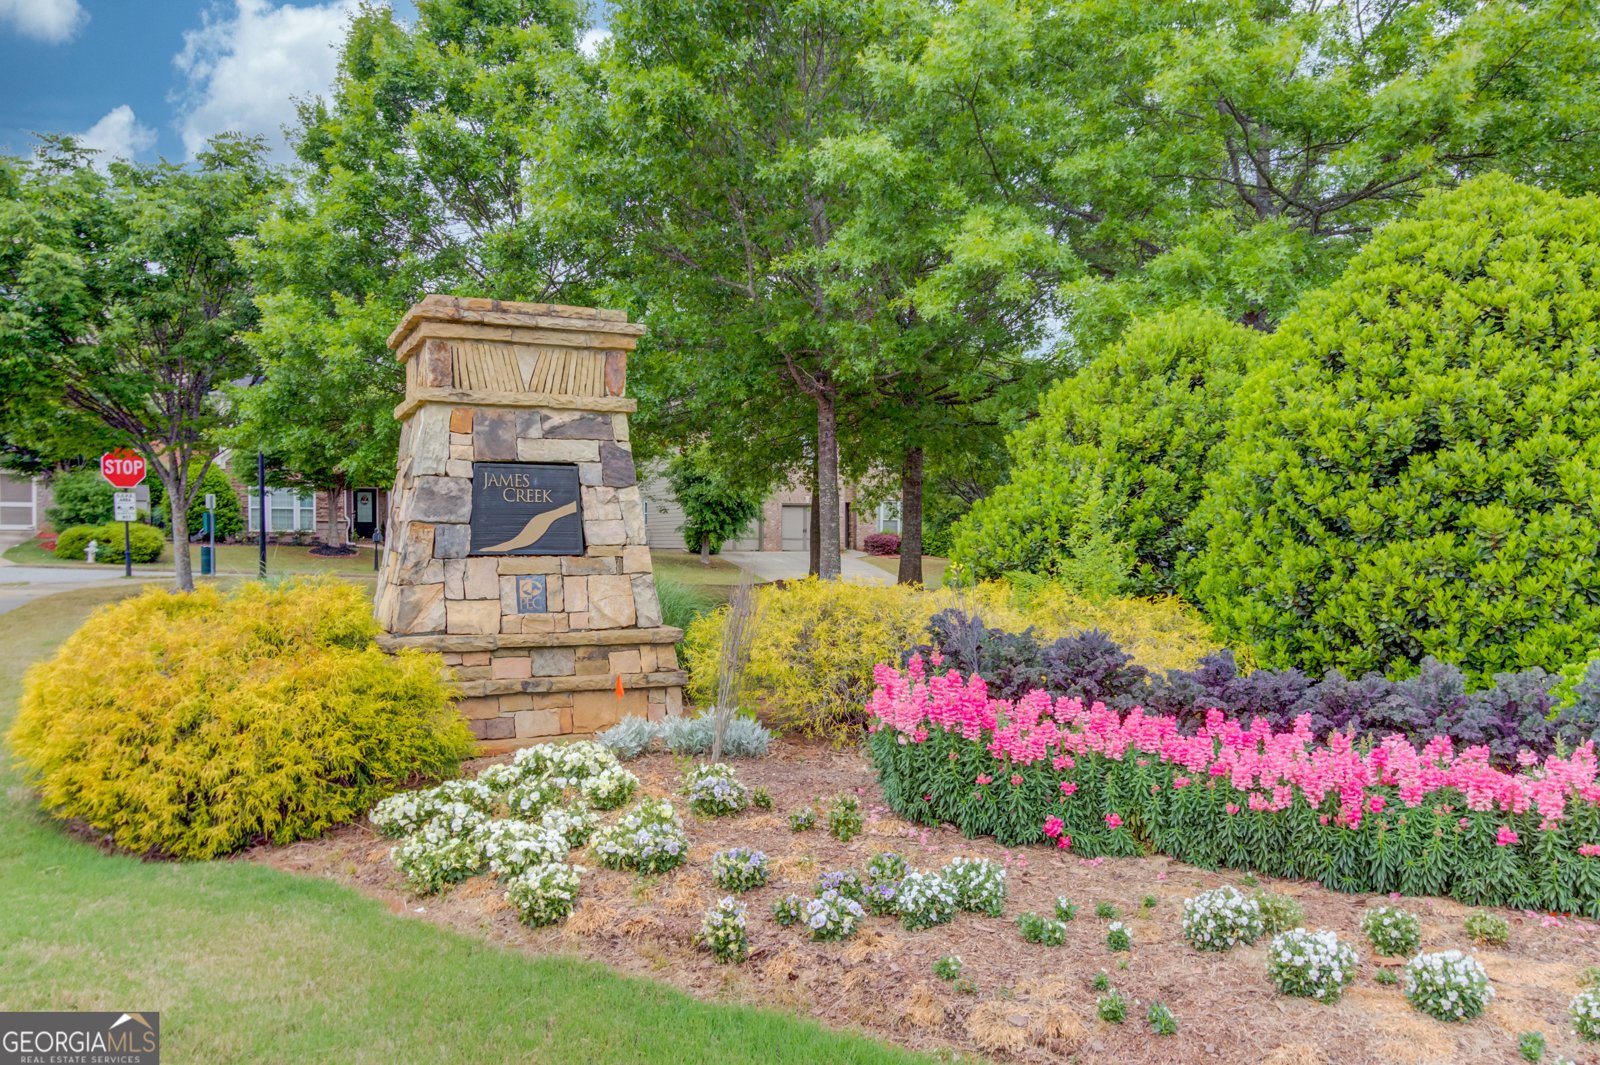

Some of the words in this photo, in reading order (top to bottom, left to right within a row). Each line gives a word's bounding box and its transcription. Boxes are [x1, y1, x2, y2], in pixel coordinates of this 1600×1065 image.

[104, 459, 143, 475] STOP
[483, 472, 530, 489] JAMES
[503, 487, 553, 503] CREEK
